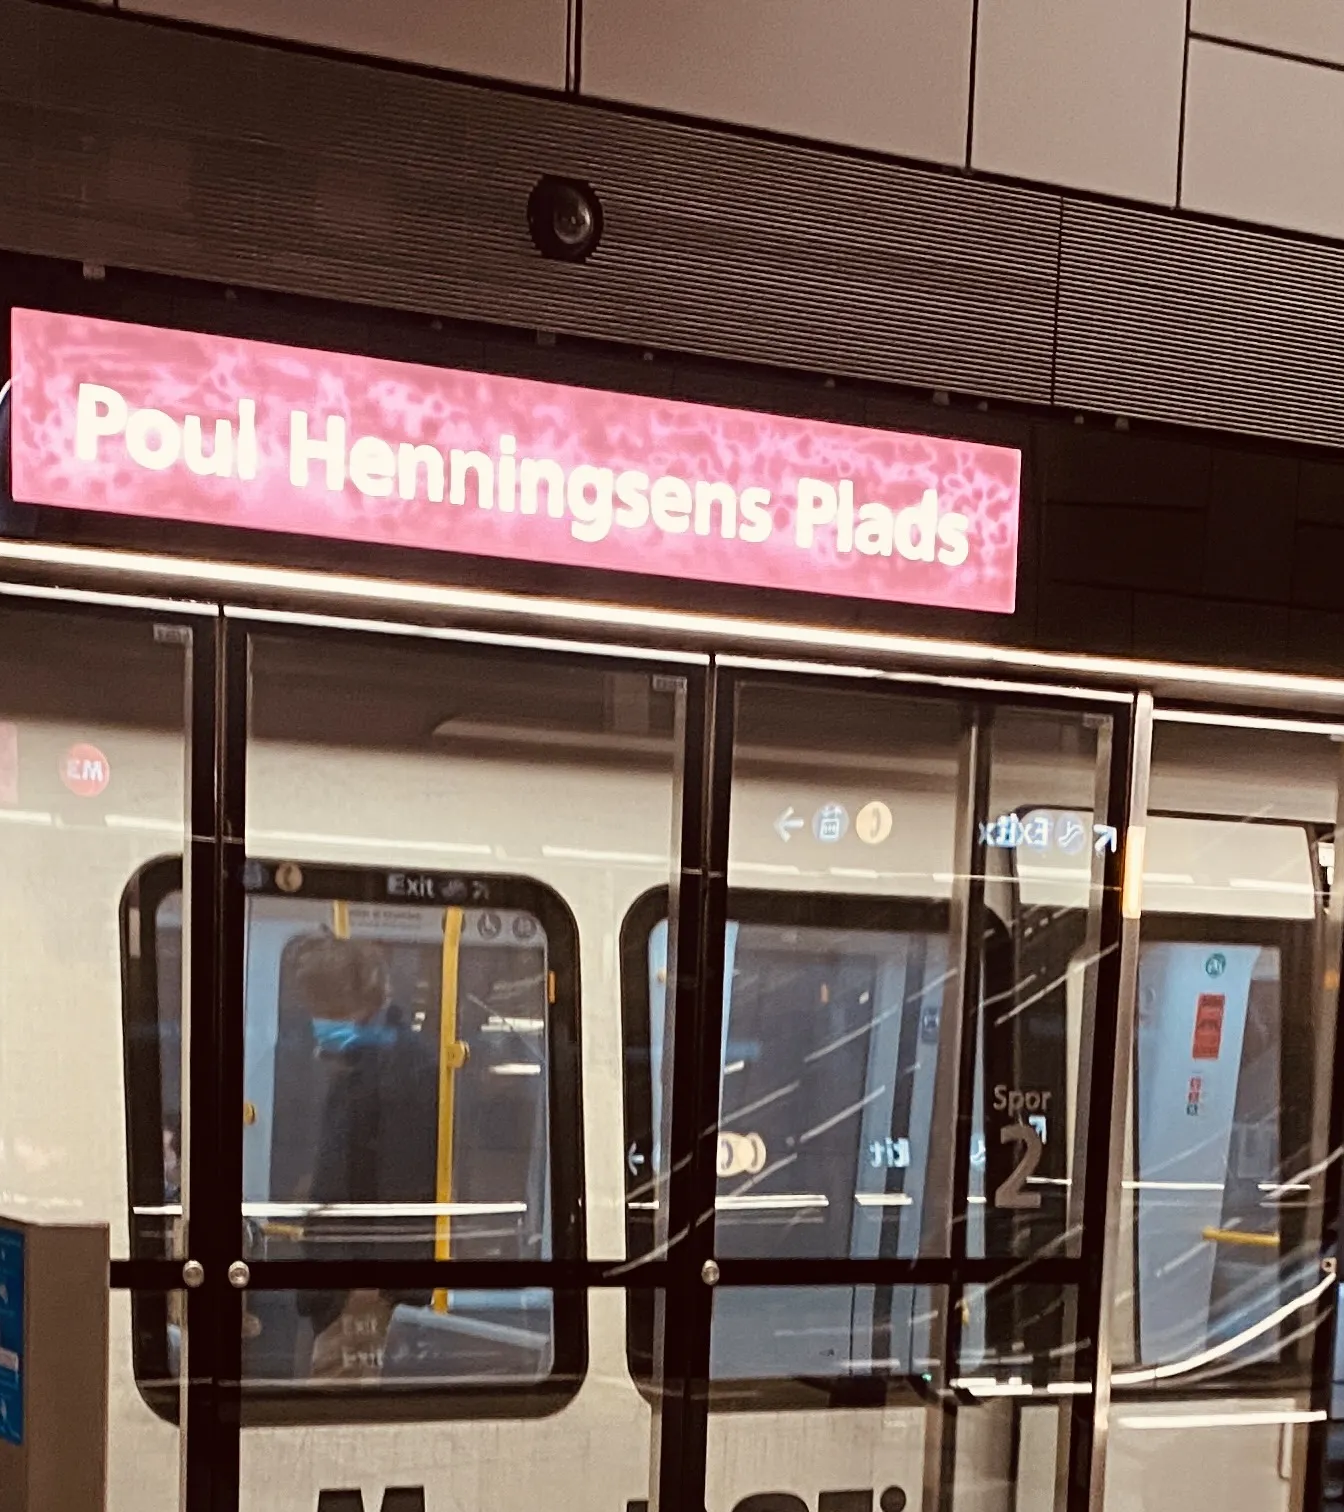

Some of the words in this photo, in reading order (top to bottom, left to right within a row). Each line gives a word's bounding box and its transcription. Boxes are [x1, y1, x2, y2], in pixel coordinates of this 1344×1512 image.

[76, 382, 256, 480] Poul
[288, 408, 772, 542] Henningsens
[795, 476, 969, 567] Plads
[387, 873, 435, 899] Exit
[993, 1083, 1052, 1115] Spor
[994, 1123, 1044, 1209] 2
